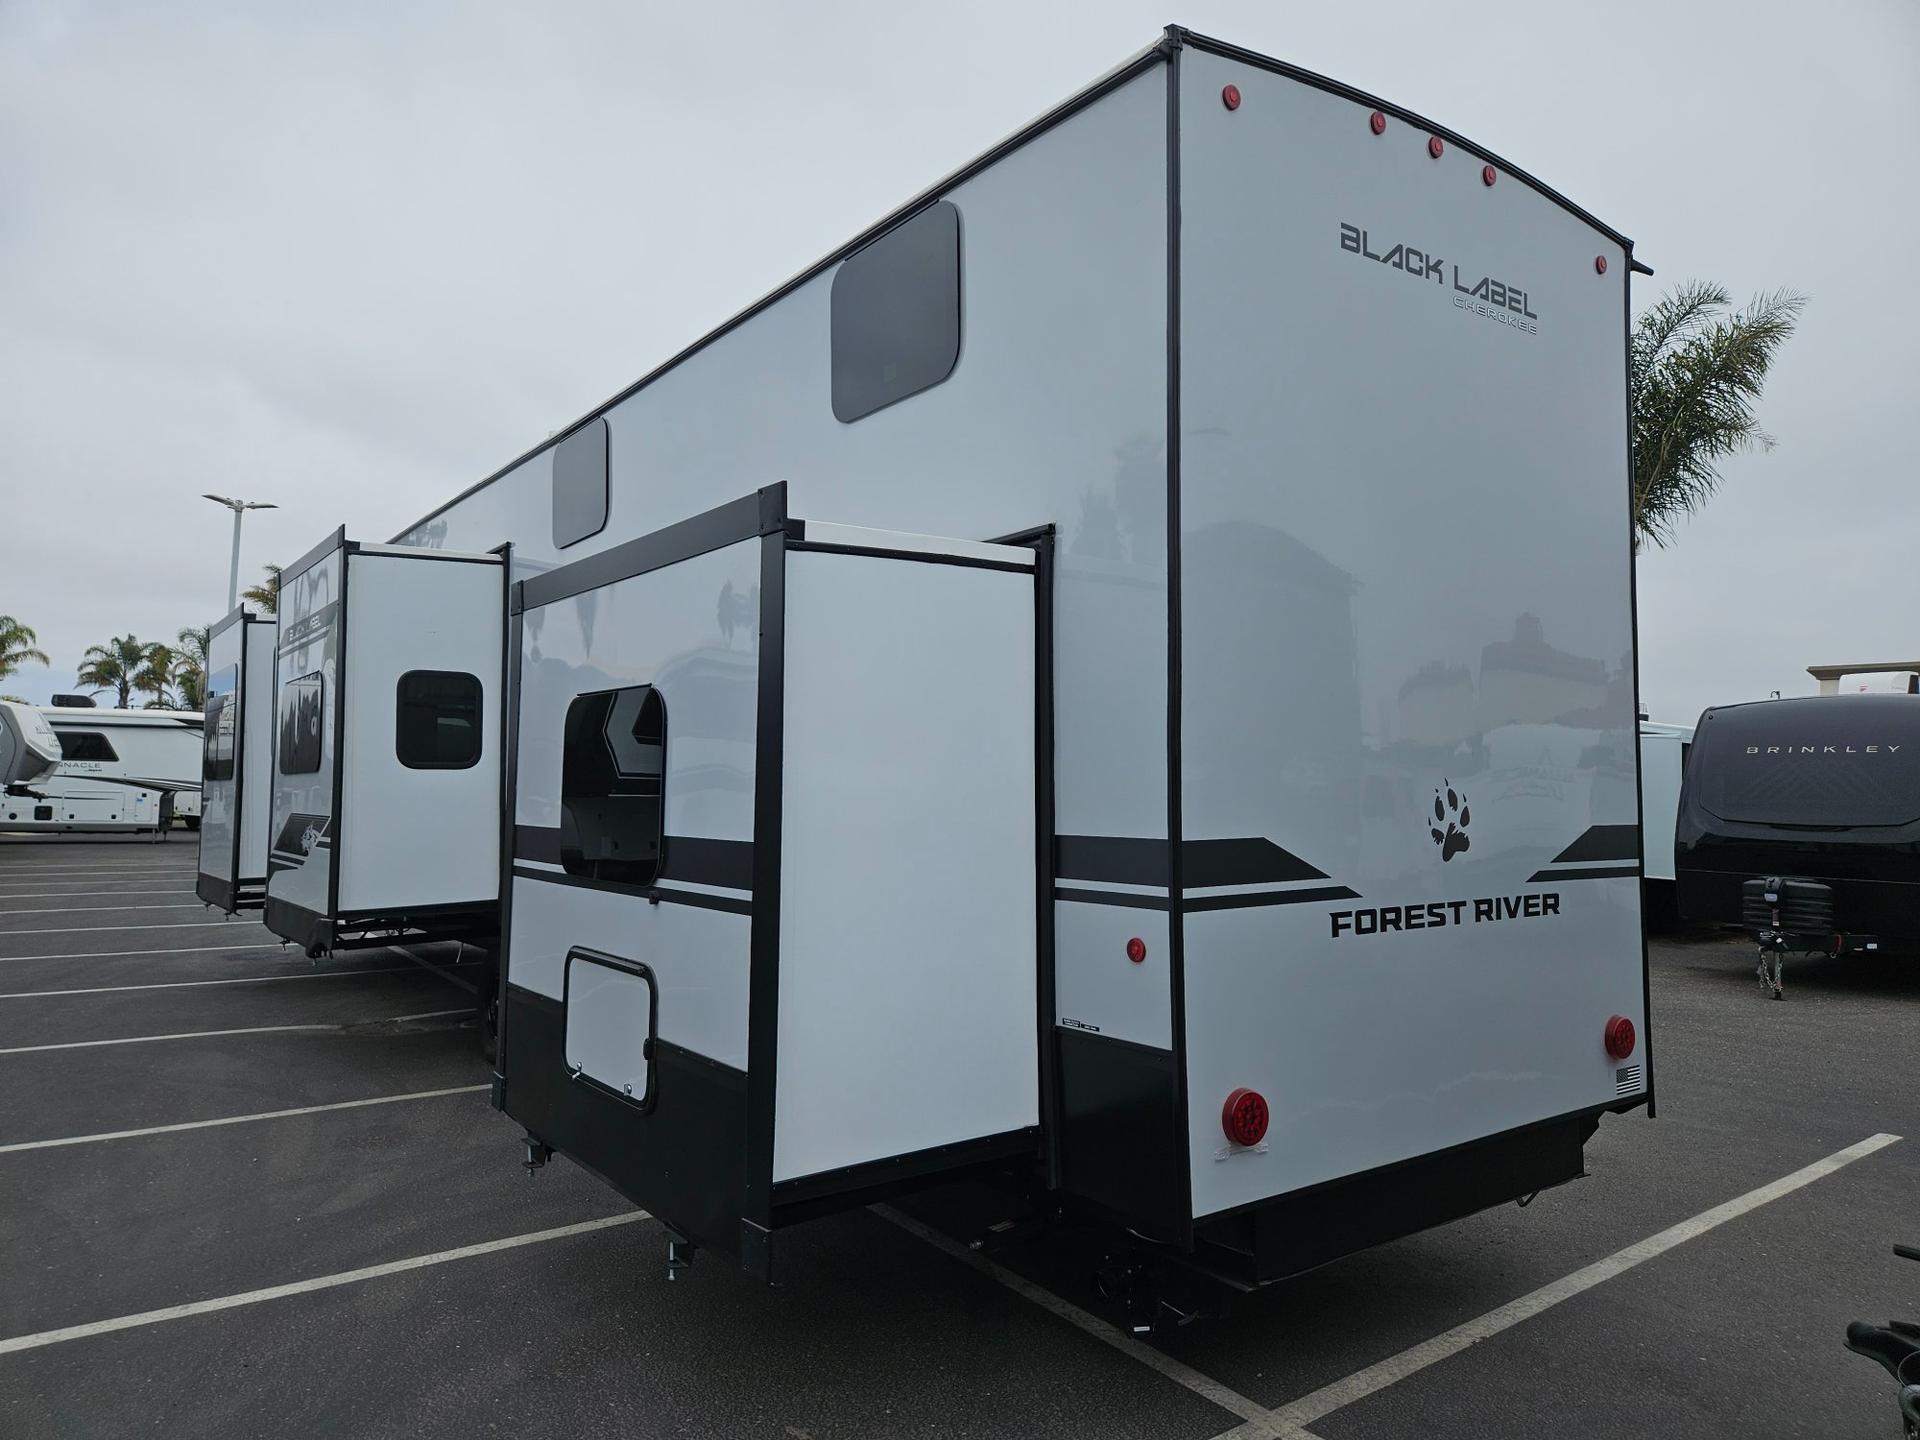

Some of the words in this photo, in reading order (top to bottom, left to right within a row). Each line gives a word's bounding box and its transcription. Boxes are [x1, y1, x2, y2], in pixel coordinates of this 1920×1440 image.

[1340, 222, 1444, 284] BLACK
[1453, 265, 1538, 320] LABEL
[1453, 296, 1537, 335] CHEROKEE
[1746, 745, 1901, 754] BRINKLEY
[1329, 901, 1467, 938] FOREST
[1473, 893, 1561, 923] RIVER
